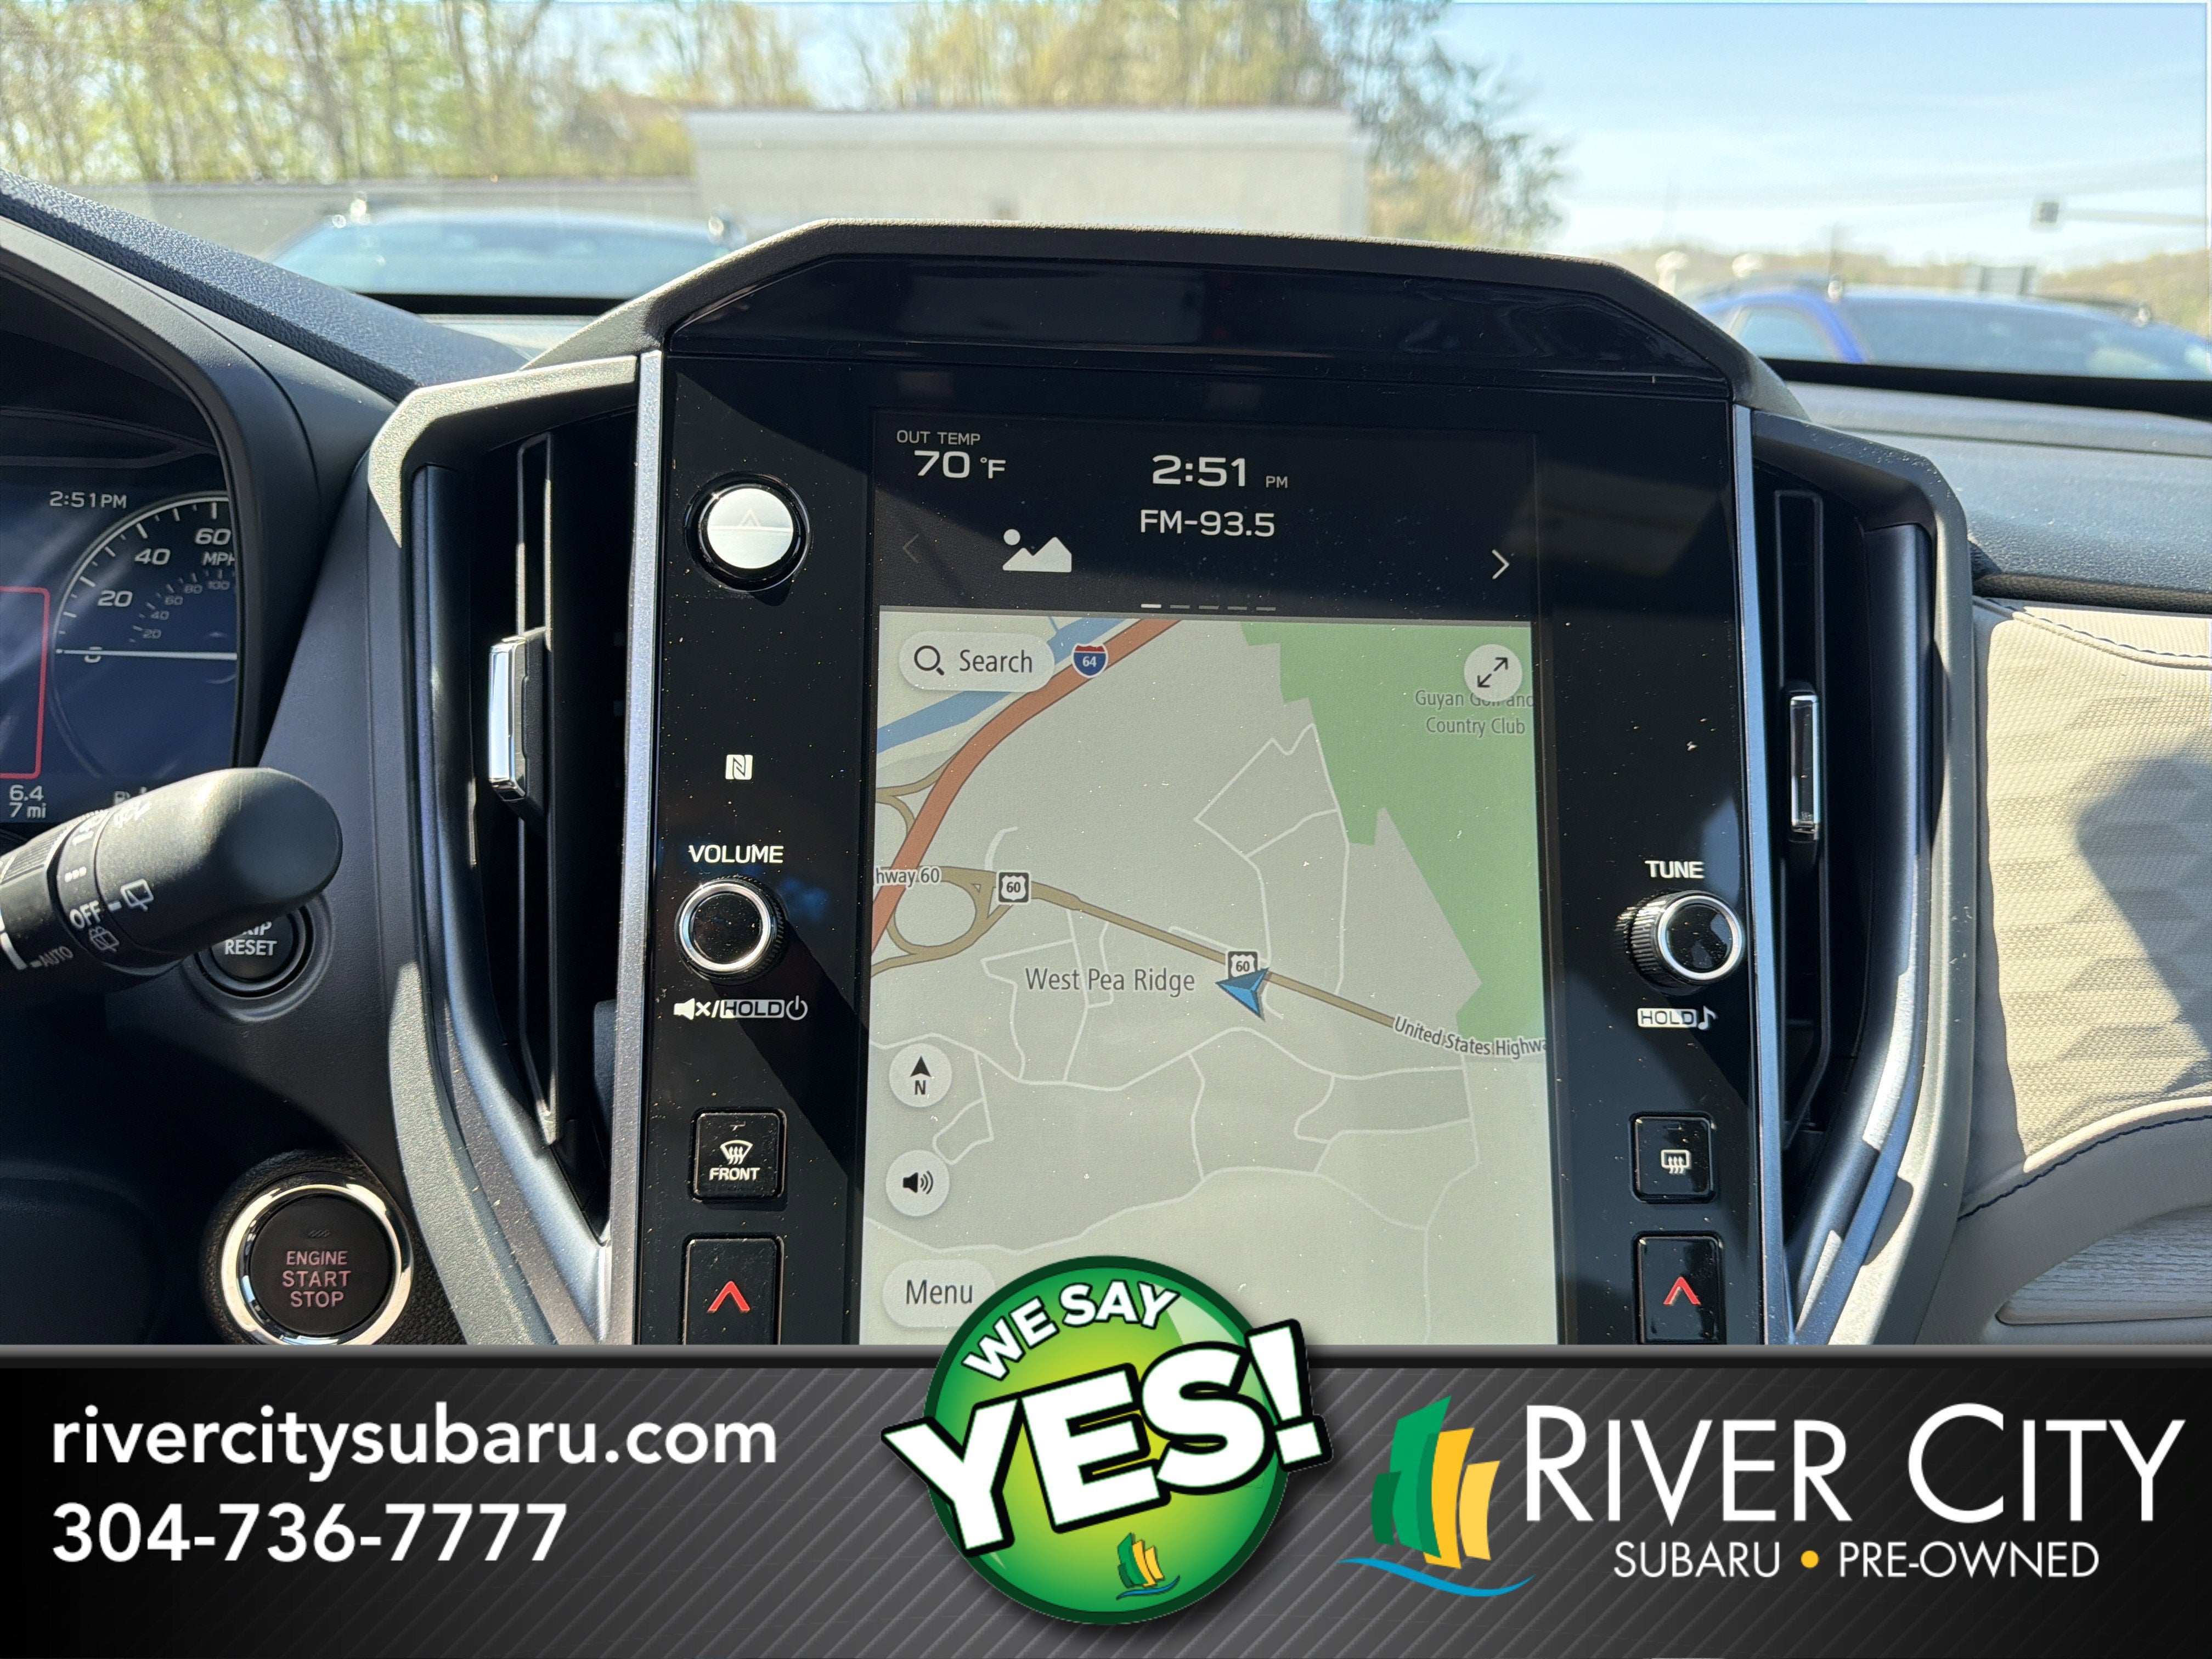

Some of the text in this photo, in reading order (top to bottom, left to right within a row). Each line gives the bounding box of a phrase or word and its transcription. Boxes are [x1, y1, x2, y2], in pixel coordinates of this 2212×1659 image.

[896, 430, 980, 445] OUT TEMP
[914, 450, 970, 478] 70
[1152, 455, 1288, 488] 2:51 PM
[1141, 509, 1275, 537] FM-93.5
[194, 528, 232, 545] 60
[134, 548, 171, 565] 40
[98, 590, 133, 607] 20
[142, 628, 161, 639] 20
[958, 648, 1033, 674] Search
[1081, 656, 1097, 668] 64
[1415, 690, 1464, 710] Guyan
[1426, 716, 1526, 738] Country Club
[9, 785, 44, 802] 6.4
[27, 803, 47, 819] mi
[689, 845, 784, 864] VOLUME
[876, 868, 940, 888] hway 60
[1644, 860, 1705, 879] TUNE
[1006, 881, 1021, 893] 60
[70, 900, 101, 930] OFF
[224, 939, 278, 956] RESET
[39, 946, 74, 968] AUTO
[1235, 960, 1250, 972] 60
[1025, 968, 1195, 997] West Pea Ridge
[724, 1000, 783, 1016] HOLD
[1640, 1011, 1695, 1026] HOLD
[1395, 1016, 1443, 1046] United
[1445, 1034, 1491, 1056] States
[915, 1080, 926, 1095] N
[709, 1167, 761, 1181] FRONT
[286, 1250, 348, 1265] ENGINE
[282, 1270, 352, 1287] START
[290, 1291, 344, 1308] STOP
[906, 1279, 973, 1305] Menu
